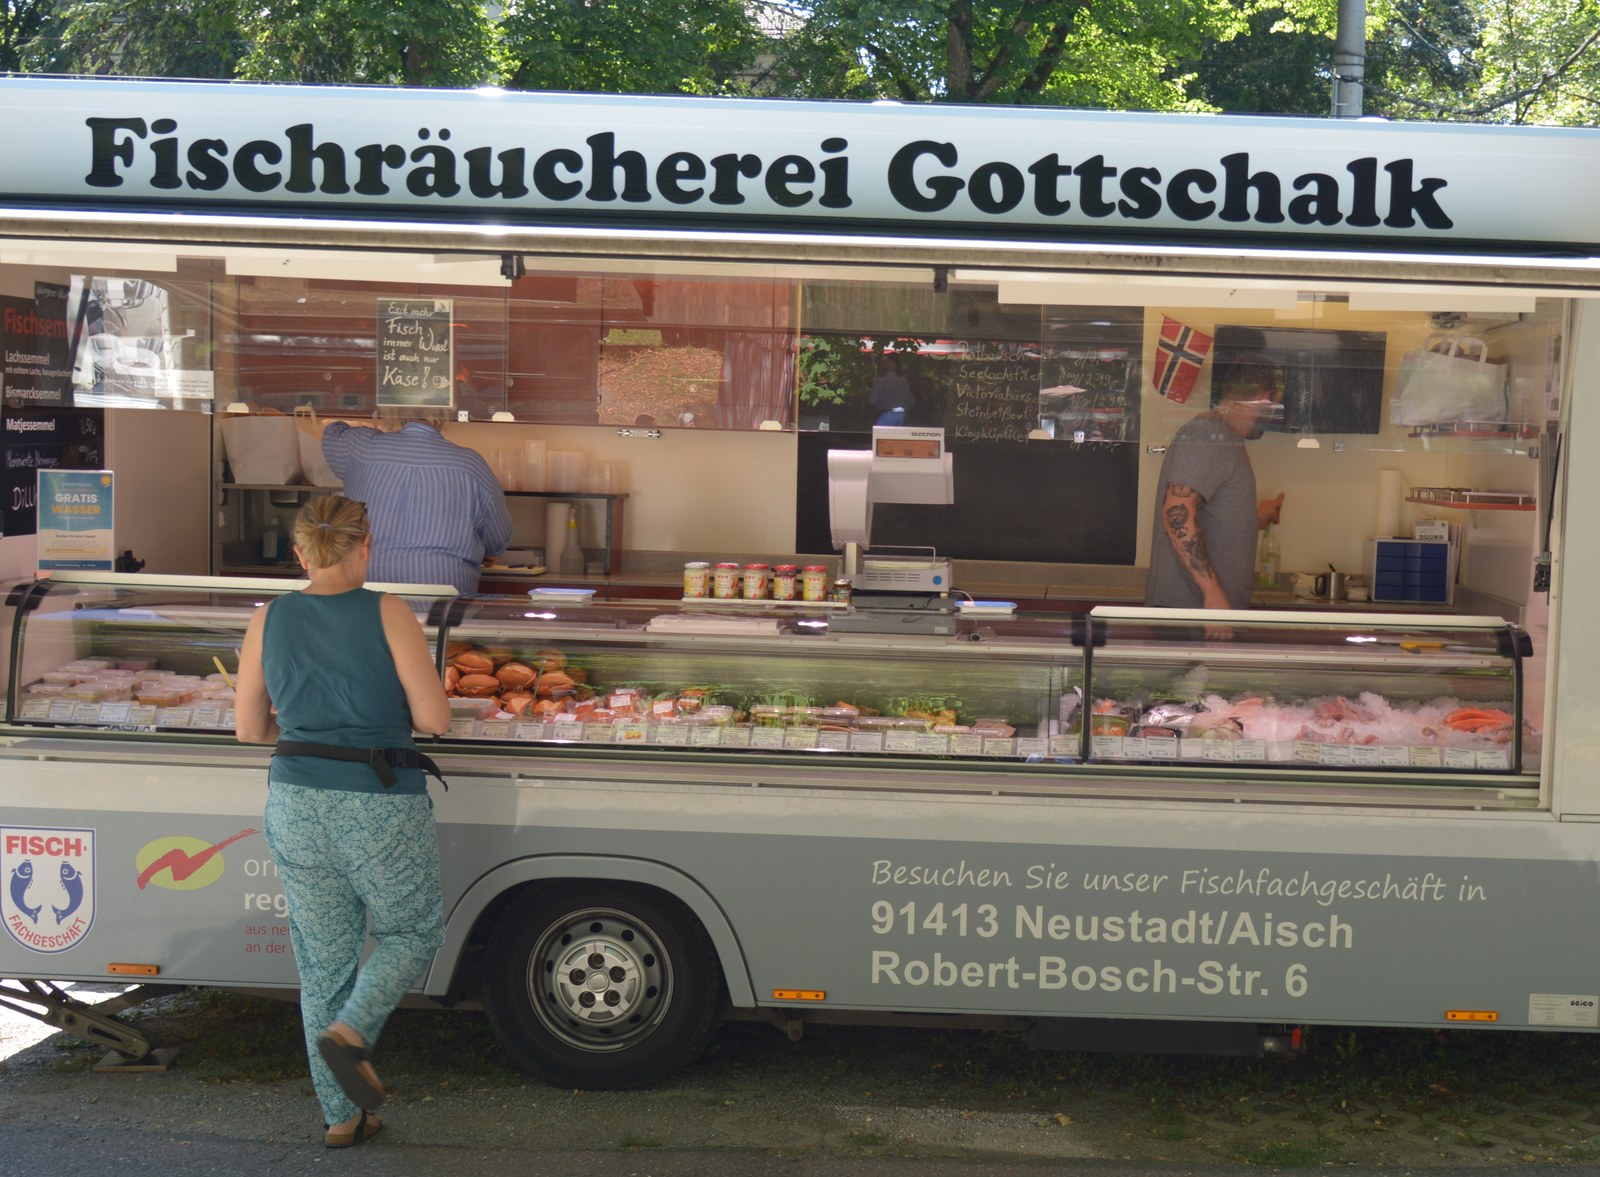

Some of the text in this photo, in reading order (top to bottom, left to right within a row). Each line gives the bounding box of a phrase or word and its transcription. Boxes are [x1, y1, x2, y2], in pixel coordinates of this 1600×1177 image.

[84, 116, 1454, 230] Fischräucherei Gottschalk
[385, 316, 423, 335] Fisch
[383, 337, 413, 348] immer
[5, 350, 50, 365] Lachssemmel
[383, 348, 440, 363] ist auch nur
[5, 386, 61, 400] Bismarcksemmel
[6, 418, 55, 433] Matjessemmel
[54, 494, 98, 503] GRATIS
[51, 505, 101, 515] WASSER
[871, 860, 1487, 906] Besuchen Sie unser Fischfachgeschäft in
[8, 914, 87, 948] FACHGESCHÄFT
[244, 925, 267, 936] aus
[871, 900, 1354, 949] 91413 Neustadt/Aisch
[245, 942, 287, 954] an der
[871, 950, 1308, 998] Robert-Bosch-Str. 6
